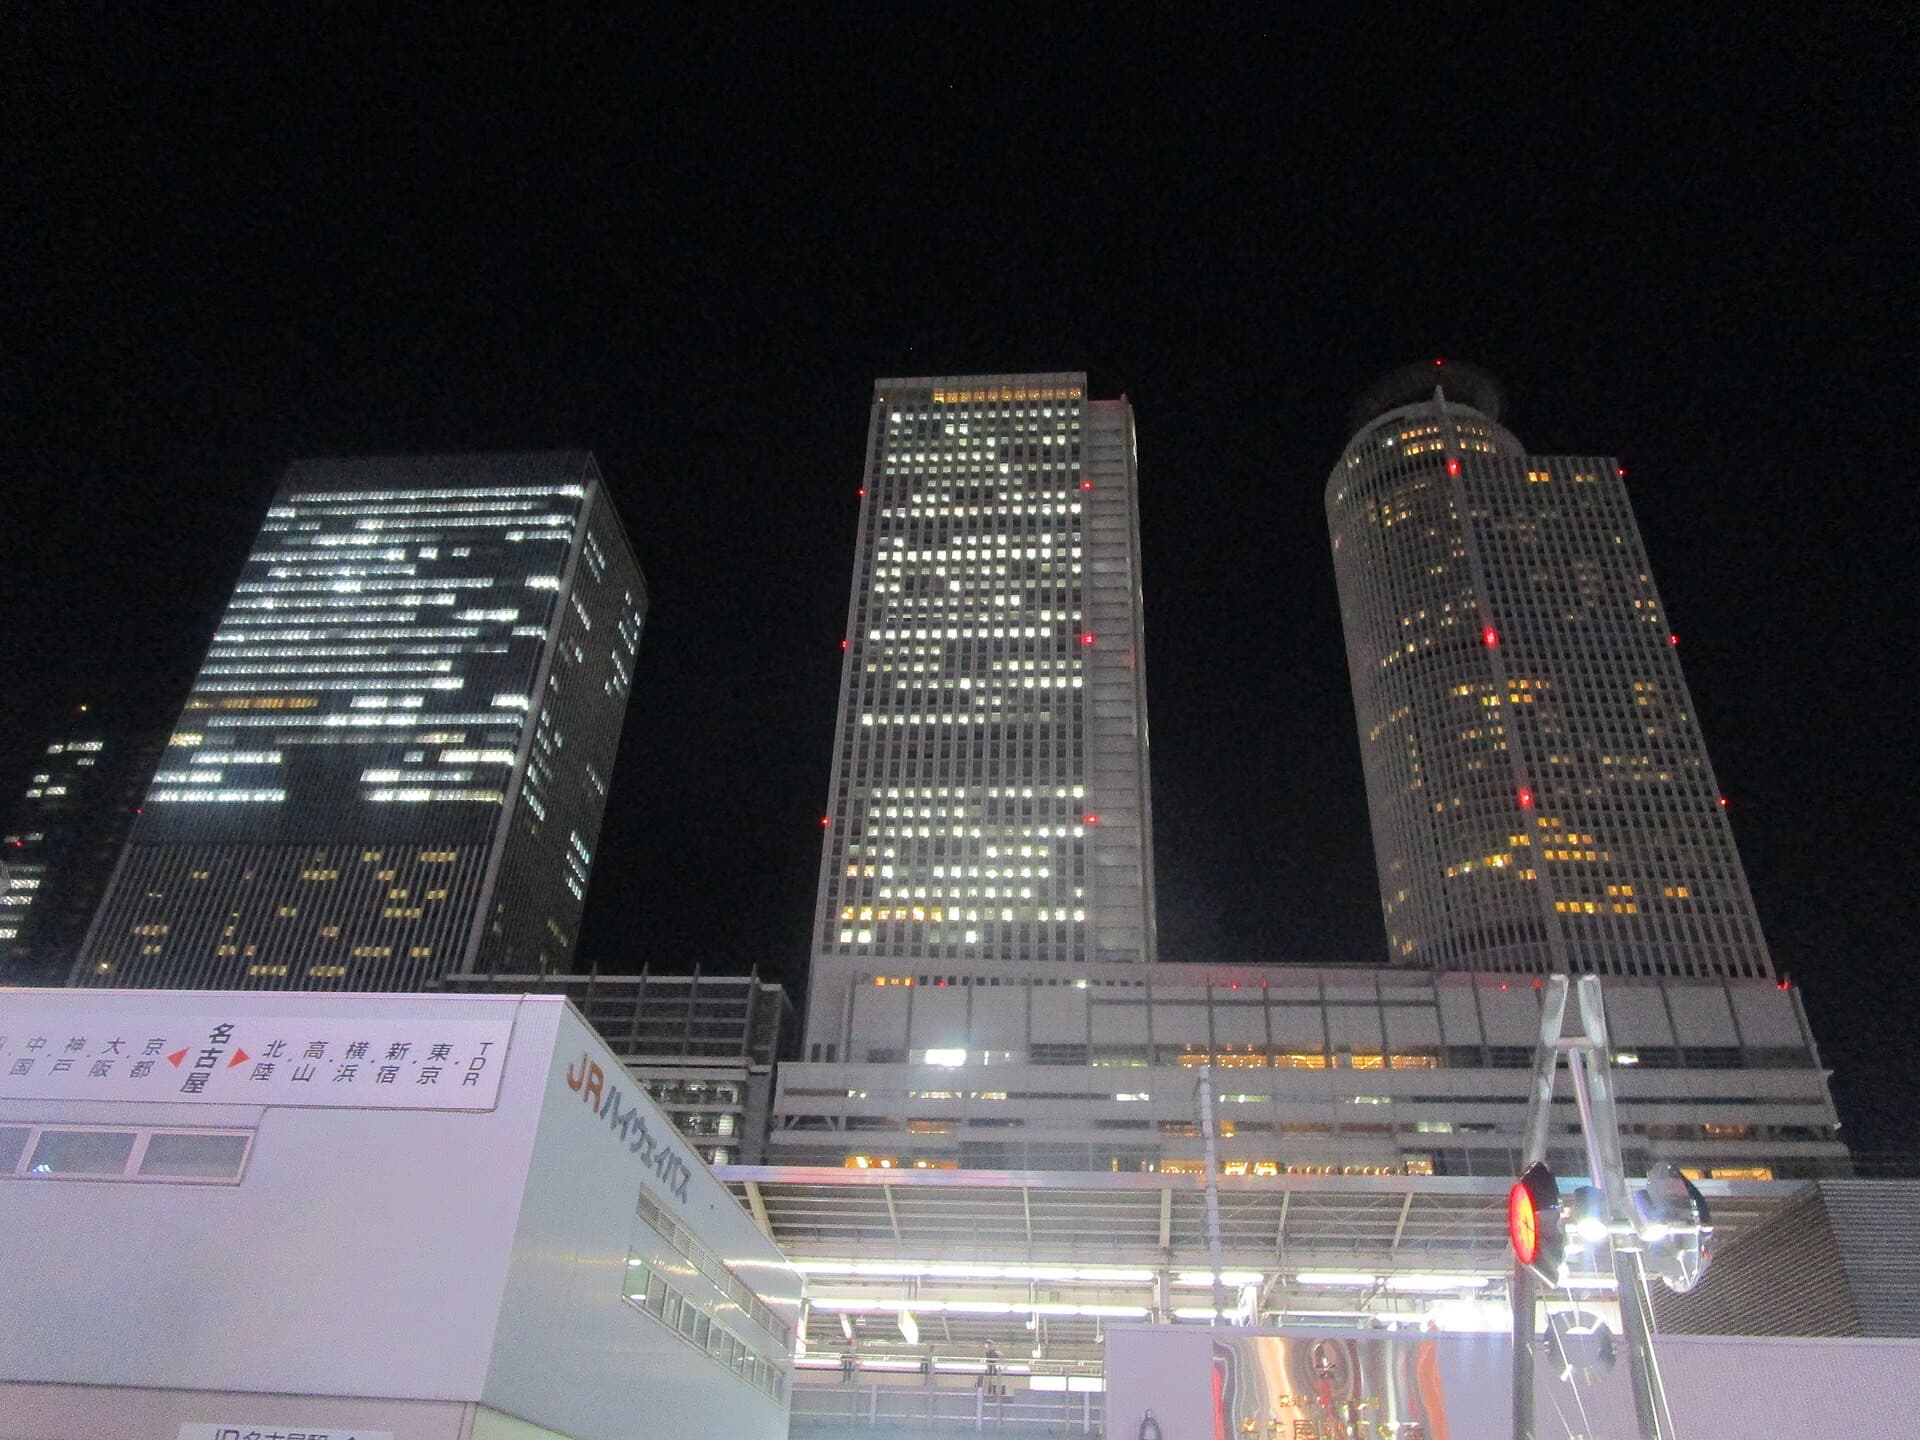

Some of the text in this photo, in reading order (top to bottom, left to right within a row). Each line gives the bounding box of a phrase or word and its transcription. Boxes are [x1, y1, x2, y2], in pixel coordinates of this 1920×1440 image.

[9, 1036, 47, 1076] 中国
[48, 1036, 86, 1077] 神戸
[88, 1037, 126, 1078] 大阪
[129, 1038, 167, 1079] 京都
[180, 1023, 235, 1094] 名古屋
[250, 1040, 287, 1082] 北陸
[291, 1041, 328, 1082] 高山
[332, 1041, 370, 1083] 横浜
[376, 1042, 412, 1084] 新宿
[416, 1043, 453, 1085] 東京
[463, 1042, 494, 1086] TDR
